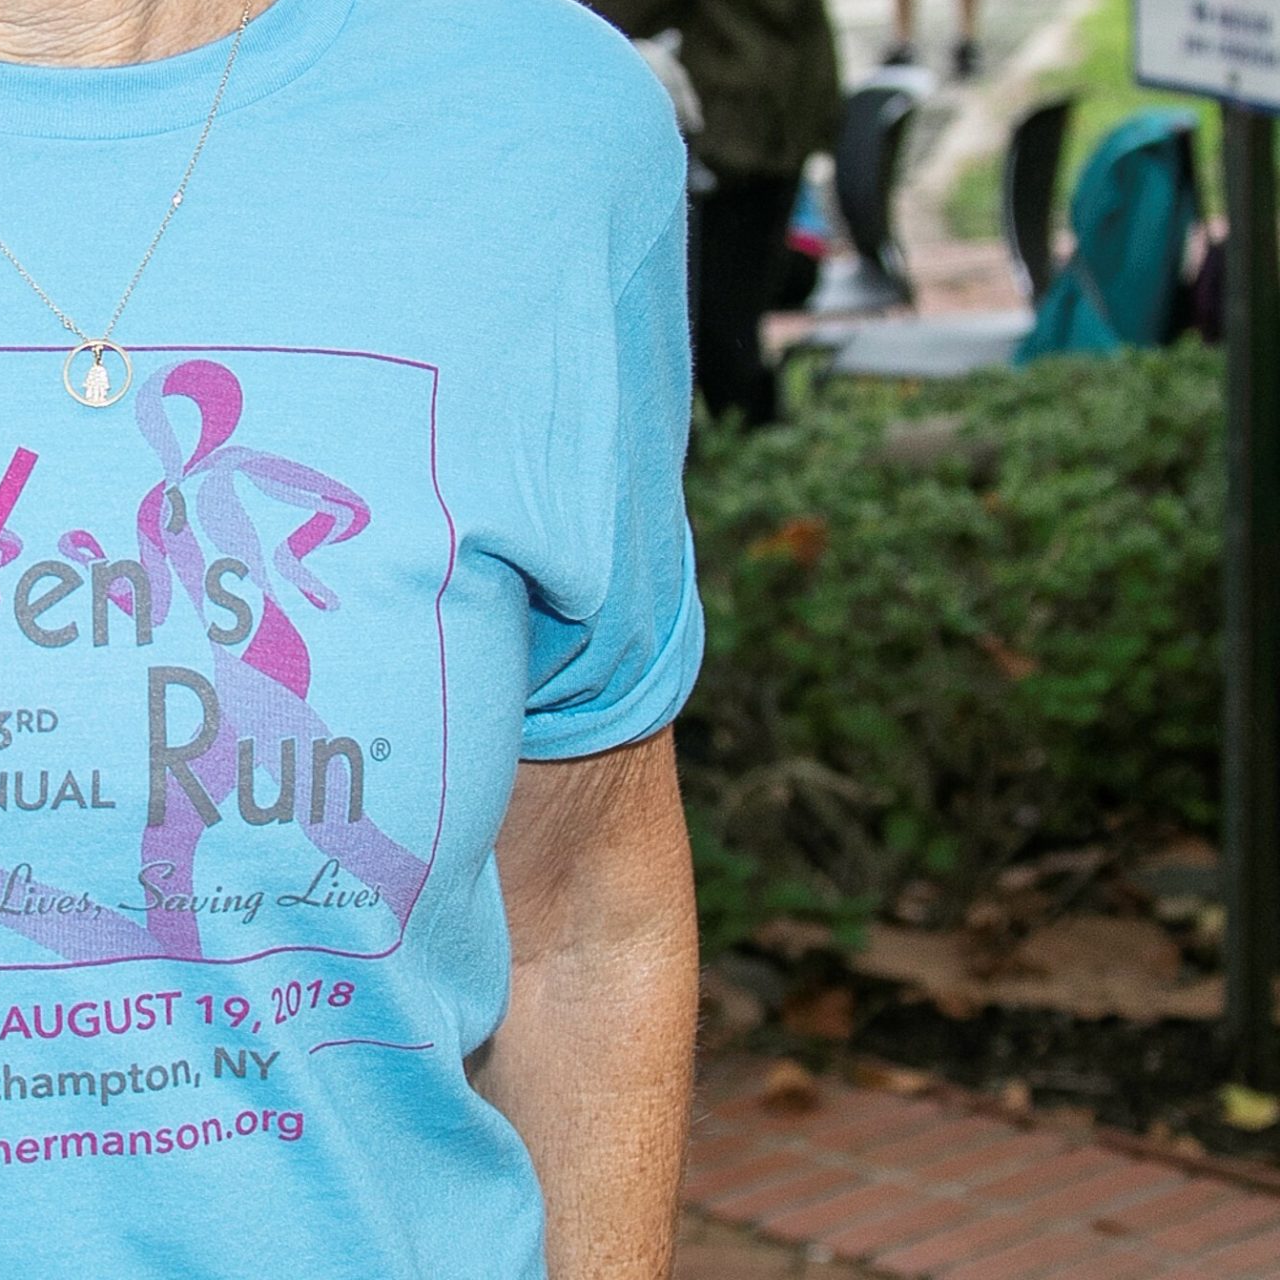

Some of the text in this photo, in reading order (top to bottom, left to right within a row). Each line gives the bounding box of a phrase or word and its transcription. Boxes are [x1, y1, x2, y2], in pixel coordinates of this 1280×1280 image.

[119, 861, 264, 923] Saving
[277, 859, 382, 911] Lives
[196, 994, 262, 1034] 19,
[271, 980, 356, 1024] 2018
[213, 1046, 280, 1082] NY
